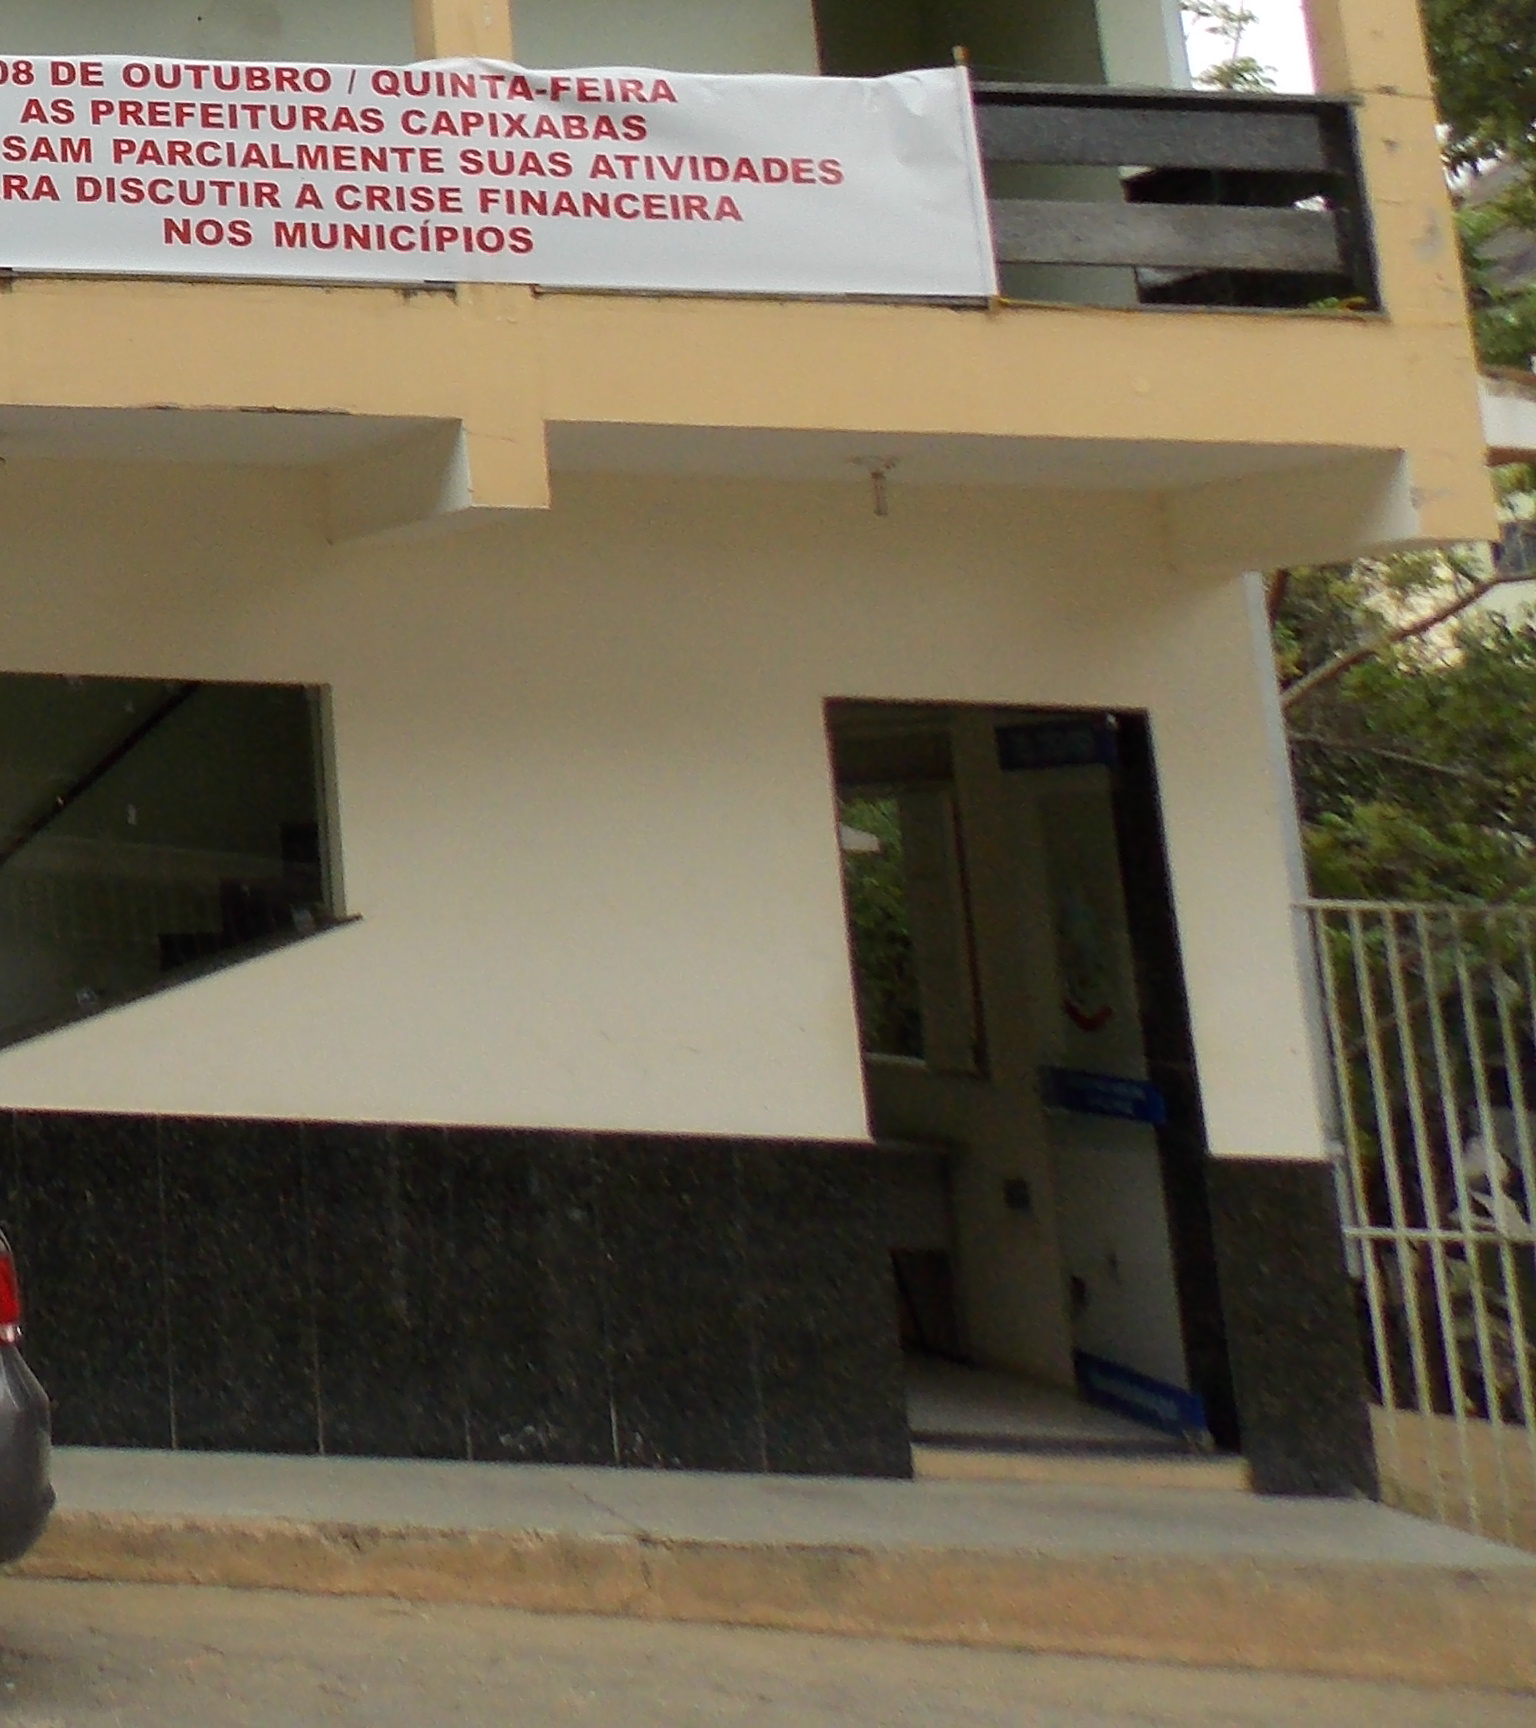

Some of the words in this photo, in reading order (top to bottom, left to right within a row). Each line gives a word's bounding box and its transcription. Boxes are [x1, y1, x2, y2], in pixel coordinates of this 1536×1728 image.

[50, 60, 104, 88] DE
[122, 62, 332, 95] OUTUBRO
[370, 68, 676, 104] QUINTA-FEIRA
[20, 98, 76, 126] AS
[90, 100, 386, 136] PREFEITURAS
[400, 108, 648, 142] CAPIXABAS
[112, 138, 443, 174] PARCIALMENTE
[459, 148, 573, 180] SUAS
[589, 154, 844, 186] ATIVIDADES
[76, 176, 280, 208] DISCUTIR
[295, 183, 323, 210] A
[334, 184, 463, 214] CRISE
[478, 188, 742, 222] FINANCEIRA
[163, 218, 254, 248] NOS
[274, 220, 535, 256] MUNICÍPIOS
